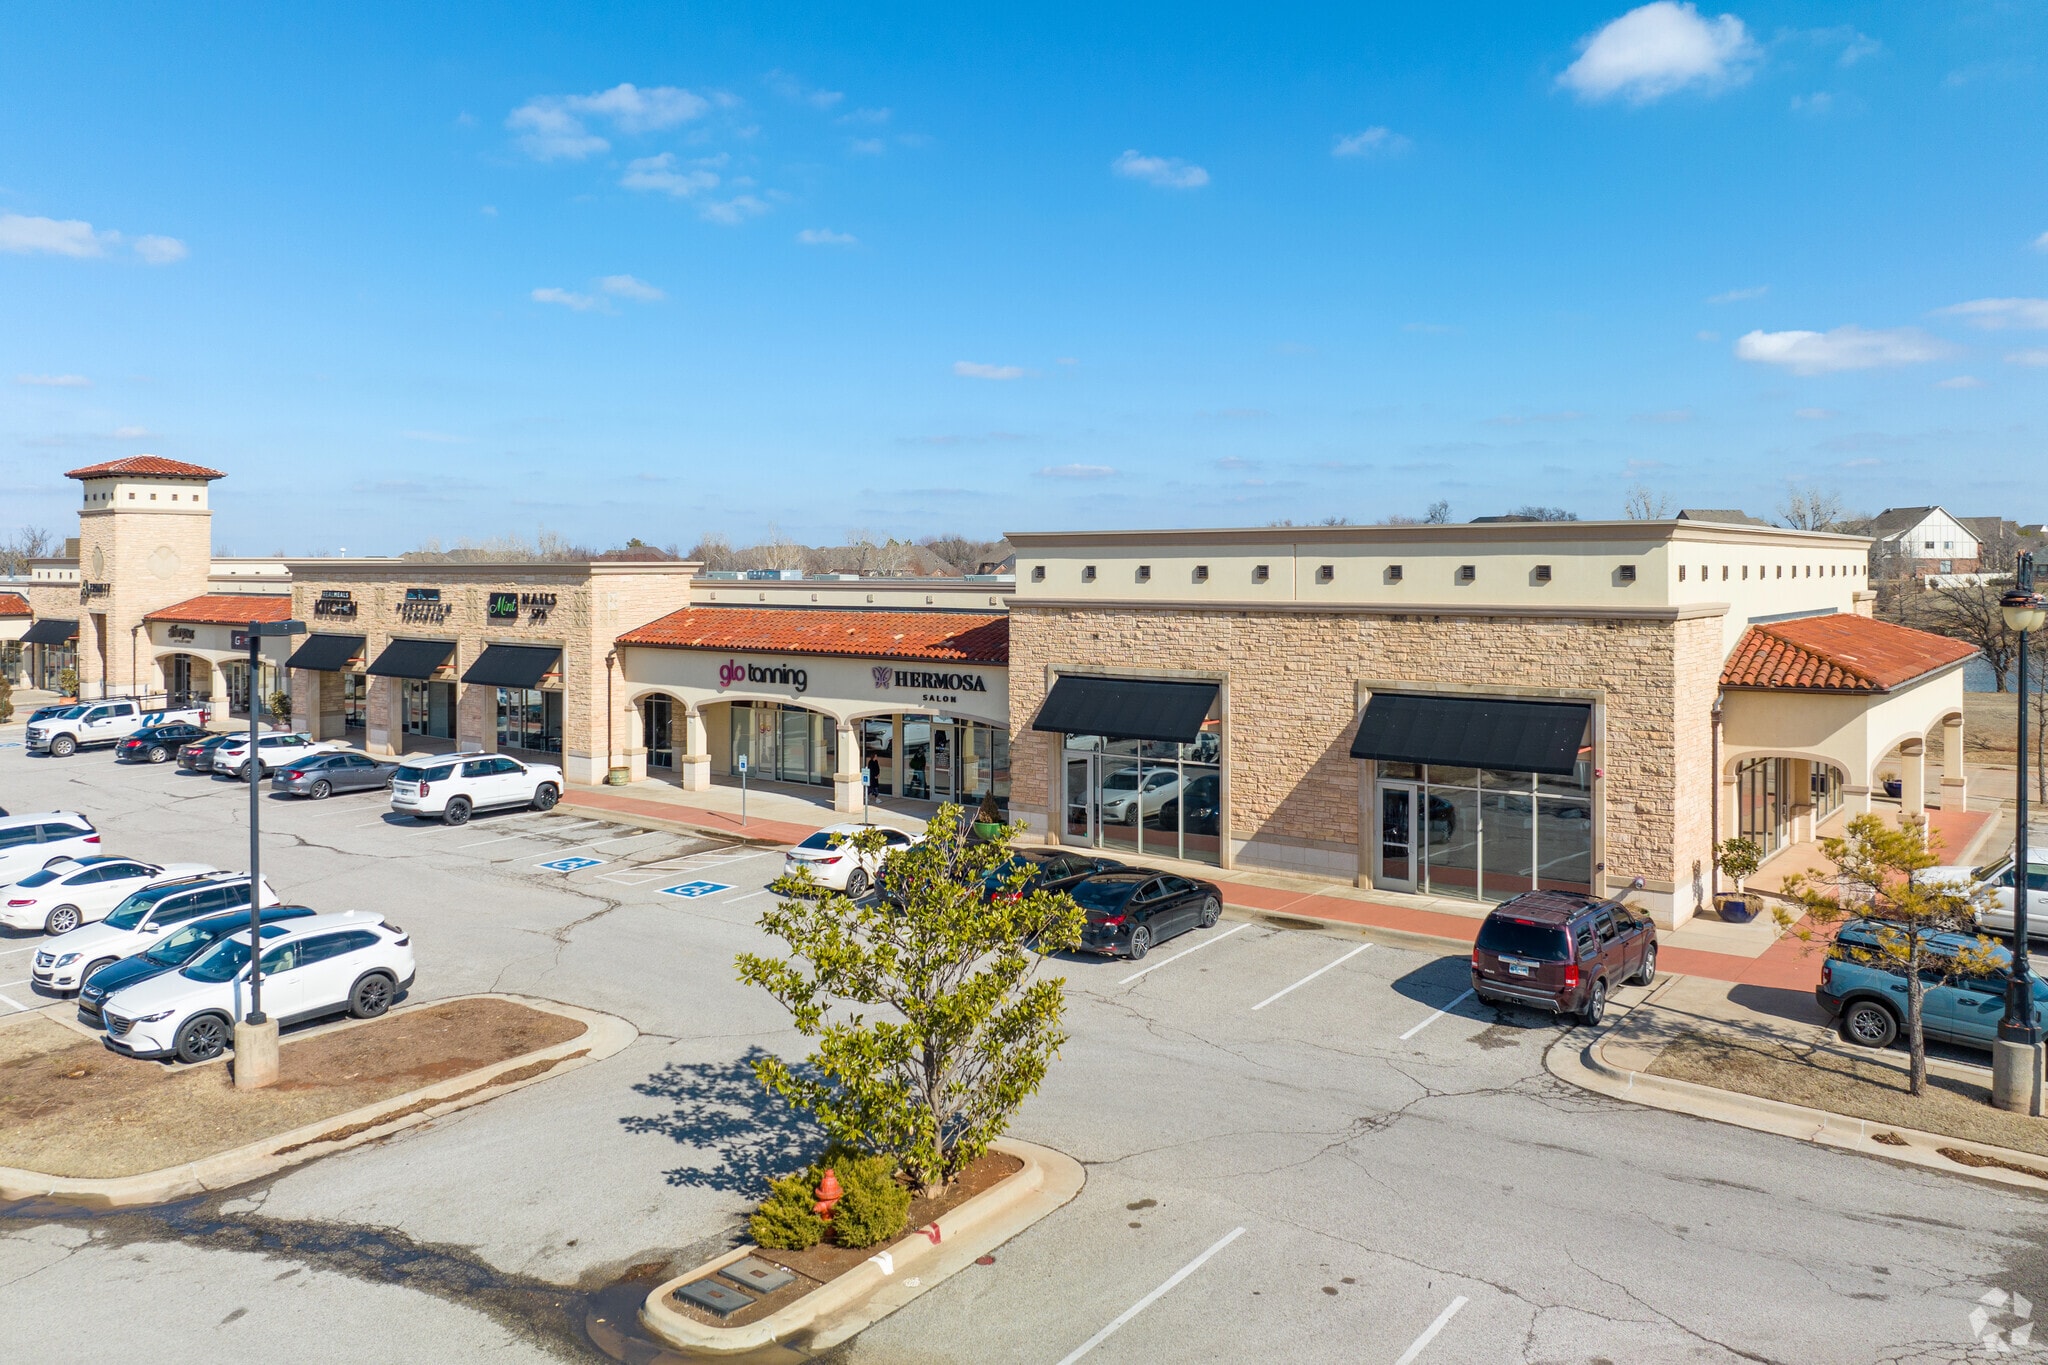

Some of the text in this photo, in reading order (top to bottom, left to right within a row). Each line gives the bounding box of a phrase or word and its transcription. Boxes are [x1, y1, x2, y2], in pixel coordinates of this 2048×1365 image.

[314, 599, 357, 615] KITCHEN
[489, 595, 517, 616] Mint
[521, 592, 557, 606] NAILS
[531, 608, 547, 619] SPA
[719, 658, 807, 692] glo tanning
[894, 671, 987, 692] HERMOSA
[922, 694, 957, 703] SALON
